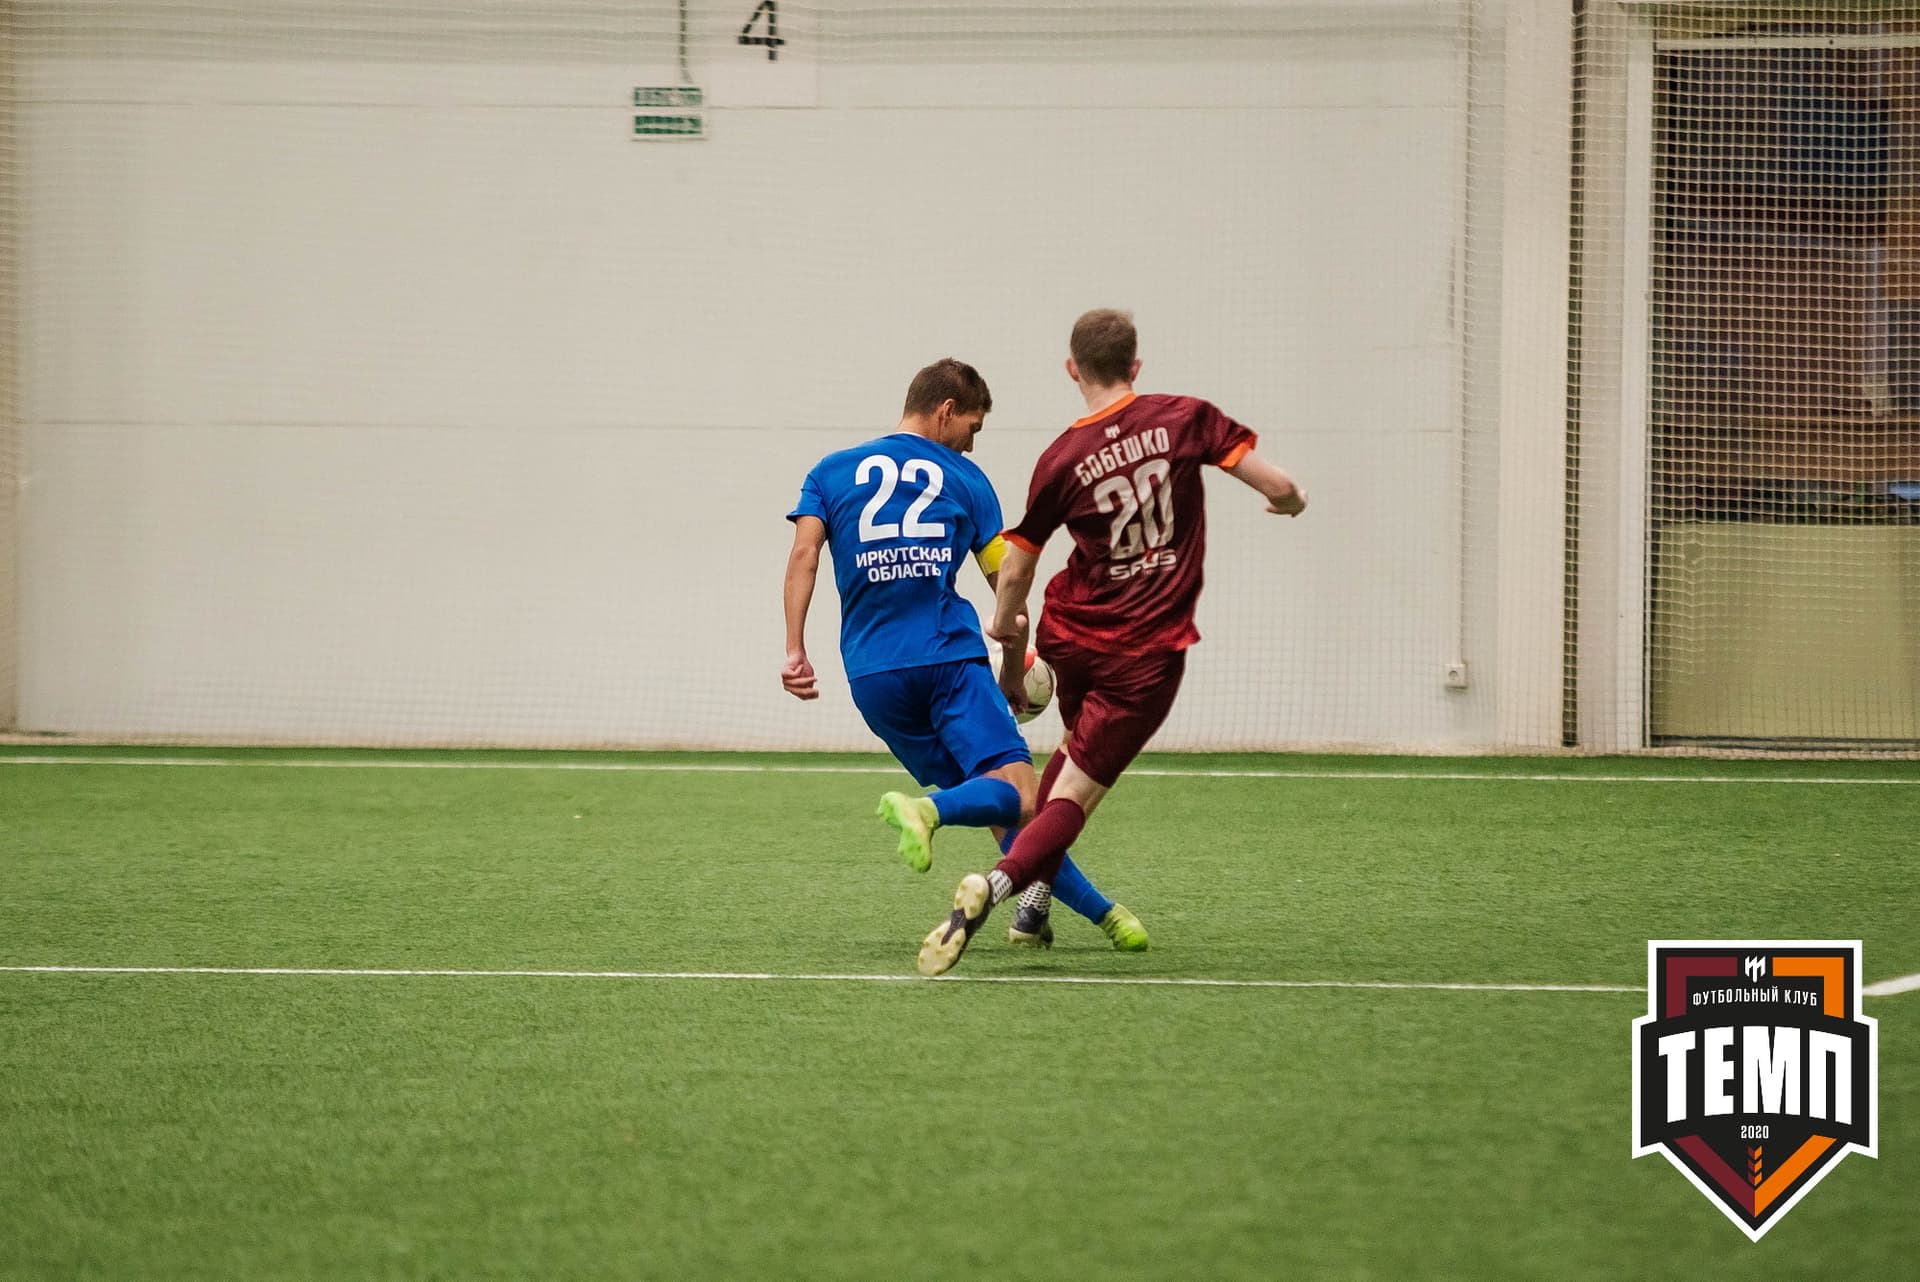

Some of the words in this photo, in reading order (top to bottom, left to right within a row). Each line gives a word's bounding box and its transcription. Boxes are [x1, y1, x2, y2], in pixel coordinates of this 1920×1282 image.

[738, 0, 786, 61] 4
[1075, 427, 1170, 486] БОБЕШКО
[855, 454, 945, 543] 22
[1093, 458, 1175, 560] 20
[855, 546, 952, 568] ИРКУТСКАЯ
[867, 562, 941, 583] ОБЛАСТЬ
